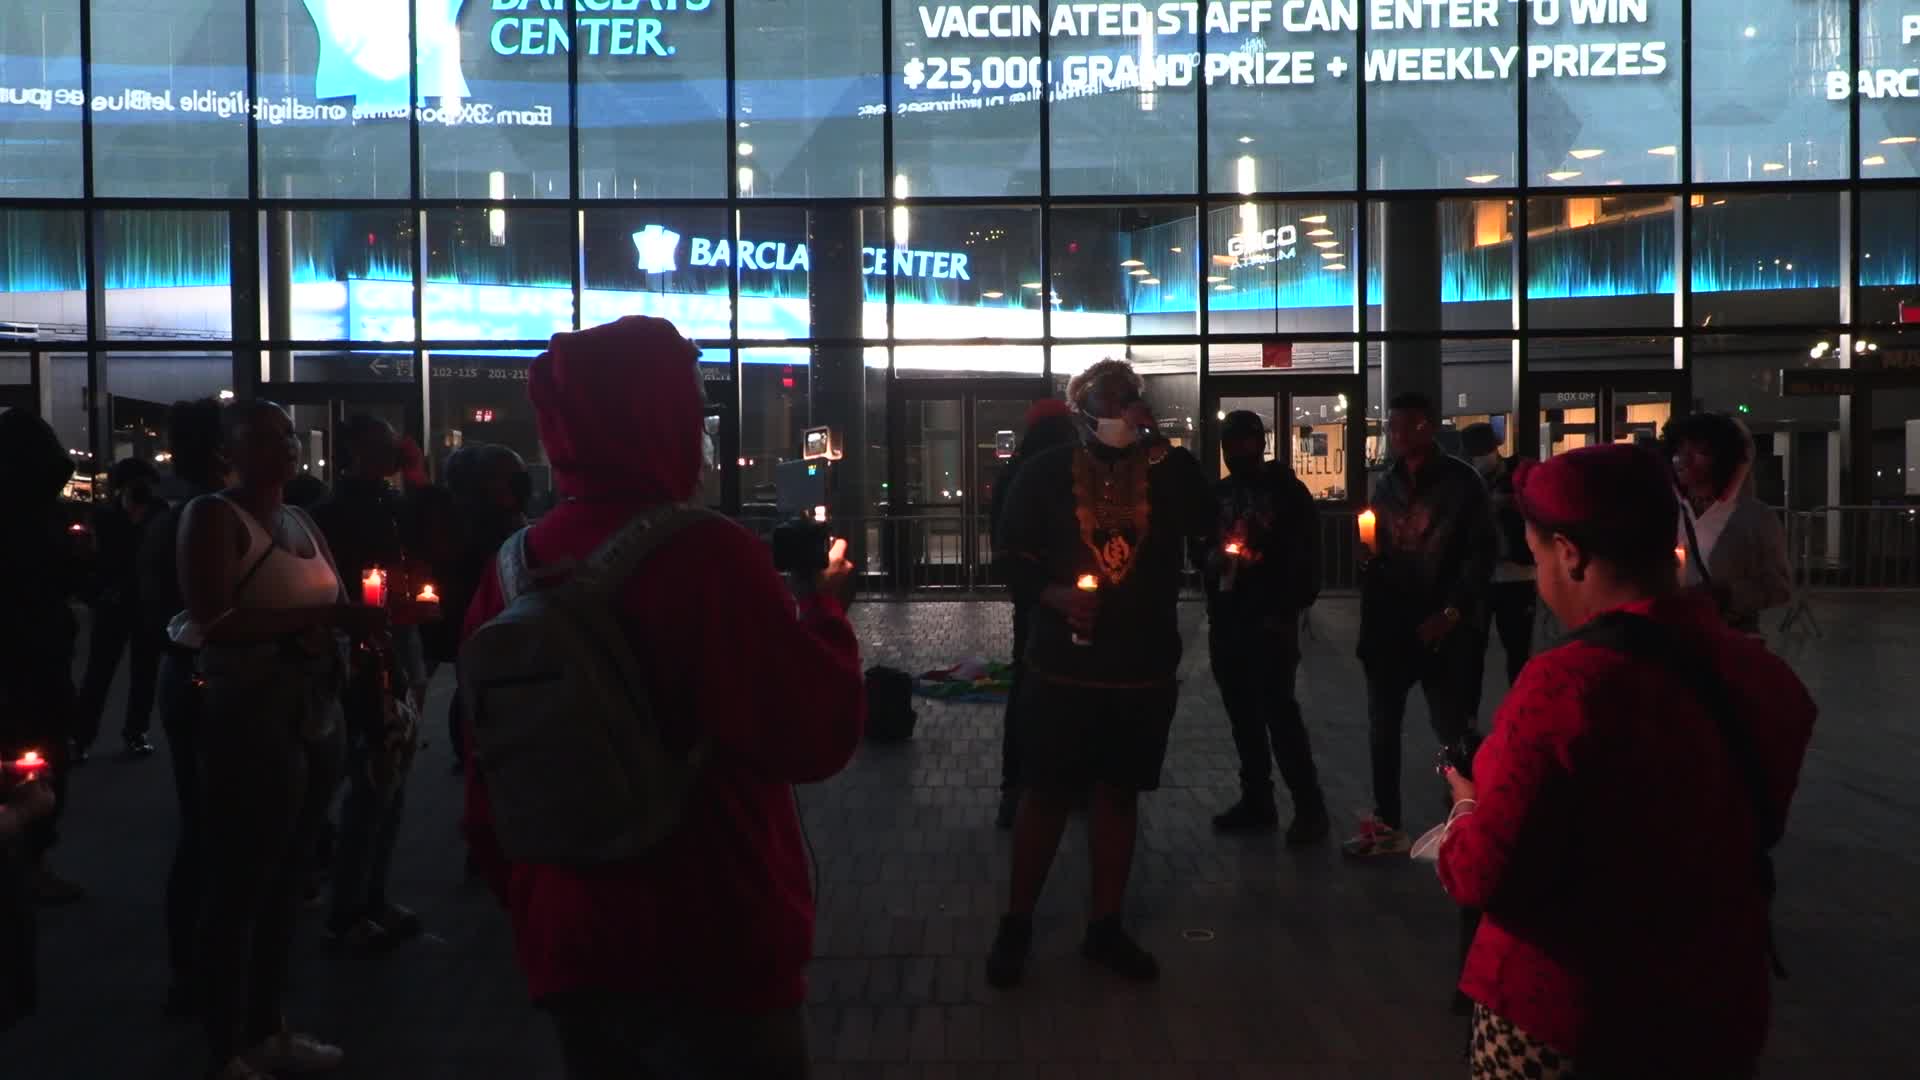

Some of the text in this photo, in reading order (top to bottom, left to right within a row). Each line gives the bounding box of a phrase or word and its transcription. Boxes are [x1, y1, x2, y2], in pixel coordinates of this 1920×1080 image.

[918, 4, 1150, 38] VACCINATED
[1157, 1, 1272, 35] STAFF
[1282, 0, 1358, 32] CAN
[1370, 0, 1500, 31] ENTER
[1570, 0, 1648, 25] WIN
[903, 56, 1052, 95] $25,000
[1062, 54, 1193, 88] GRAND
[1204, 51, 1315, 87] PRIZE
[1364, 45, 1520, 82] WEEKLY
[1527, 41, 1667, 79] PRIZES
[690, 236, 971, 281] BARCLA CENTER
[1295, 448, 1343, 475] HELLO
